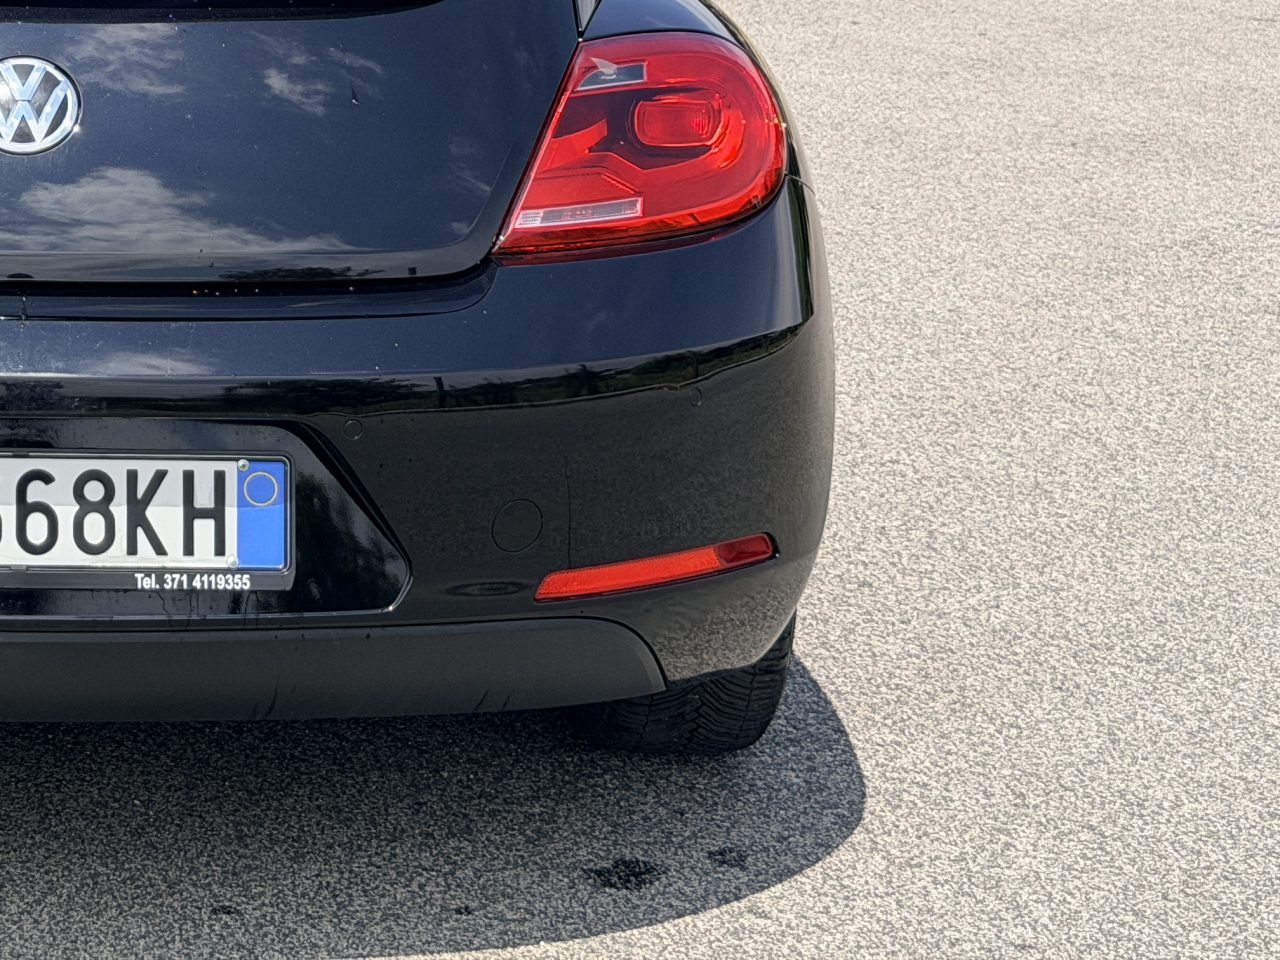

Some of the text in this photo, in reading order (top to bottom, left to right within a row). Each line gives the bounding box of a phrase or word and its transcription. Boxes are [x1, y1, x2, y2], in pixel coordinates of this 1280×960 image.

[134, 573, 251, 590] Tel. 371 4119355
